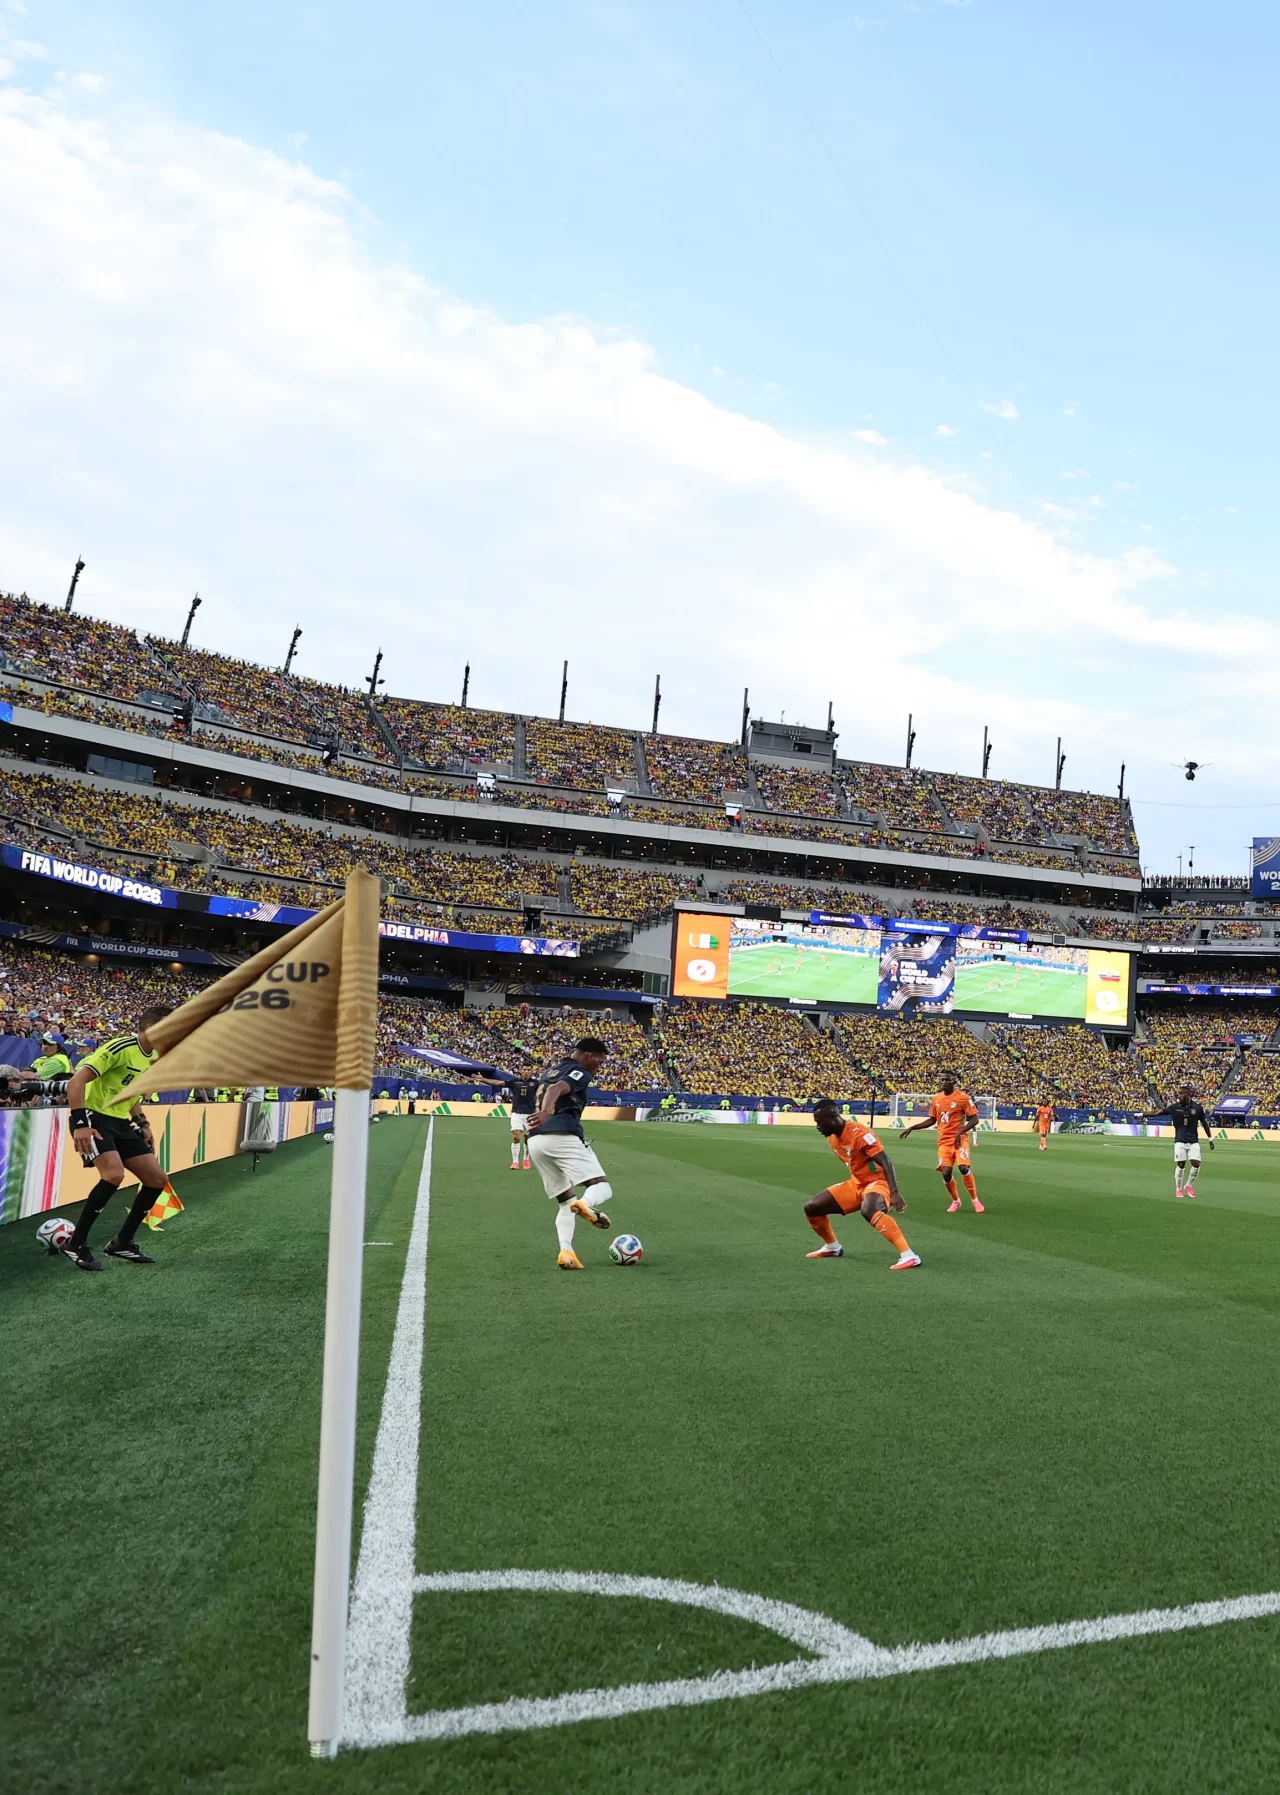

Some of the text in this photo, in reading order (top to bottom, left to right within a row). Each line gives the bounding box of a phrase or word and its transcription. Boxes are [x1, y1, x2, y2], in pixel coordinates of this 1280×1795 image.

[21, 851, 52, 876] FIFA
[52, 859, 98, 887] WORLD
[99, 873, 122, 894] CUP
[66, 936, 179, 958] FIFA WORLD CUP 2026
[266, 962, 330, 983] CUP
[900, 961, 917, 969] FIFA
[900, 968, 928, 977] WORLD
[941, 1111, 949, 1123] 24
